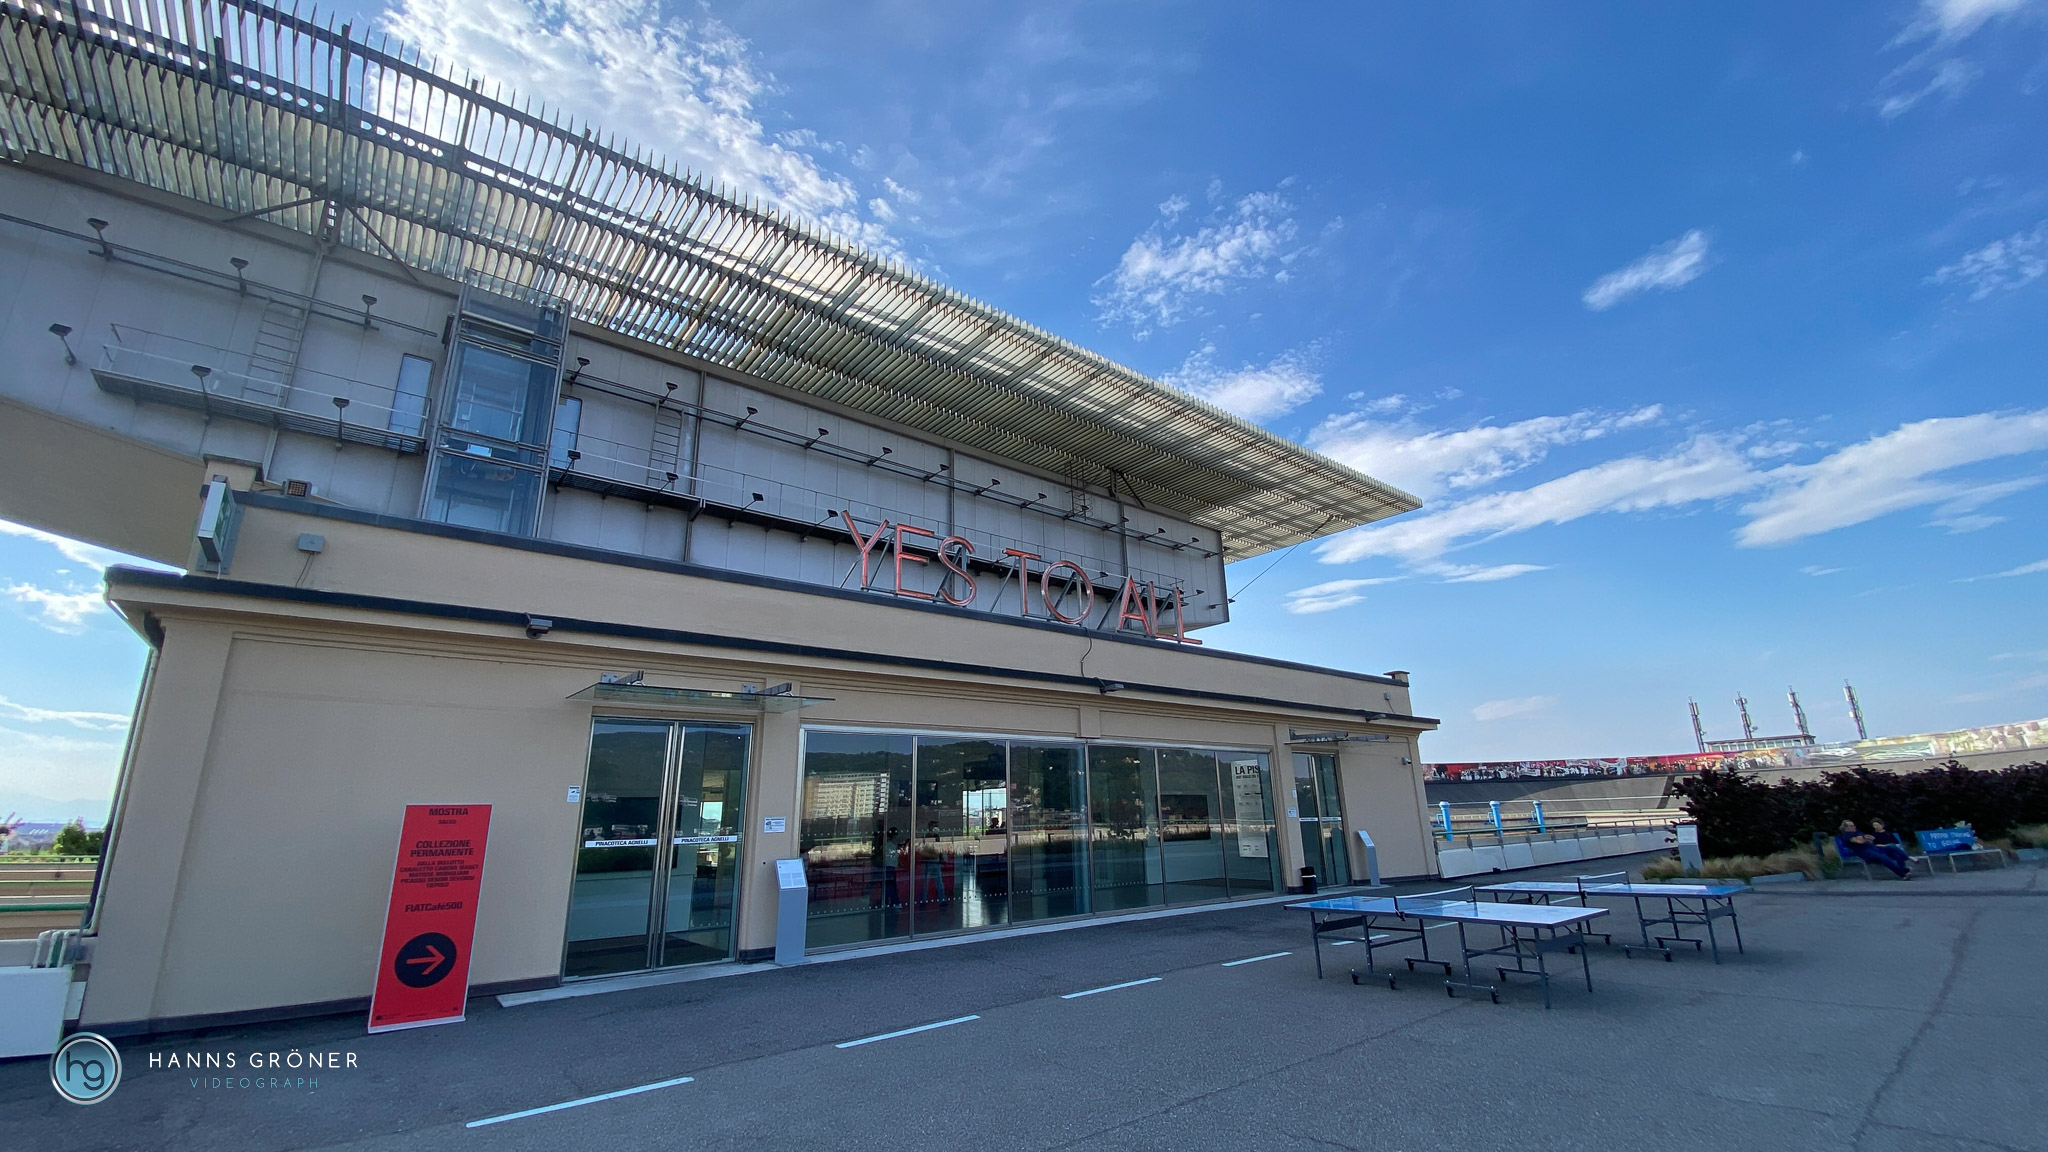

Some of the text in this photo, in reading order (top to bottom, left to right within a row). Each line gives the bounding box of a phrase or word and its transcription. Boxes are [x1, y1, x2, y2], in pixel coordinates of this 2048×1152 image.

[841, 509, 1203, 645] YES TO ALL
[1235, 765, 1246, 775] LA
[428, 808, 469, 816] MOSTRA
[416, 839, 471, 849] COLLEZIONE
[410, 848, 474, 857] PERMANENTE
[405, 901, 463, 912] FIATCafé500
